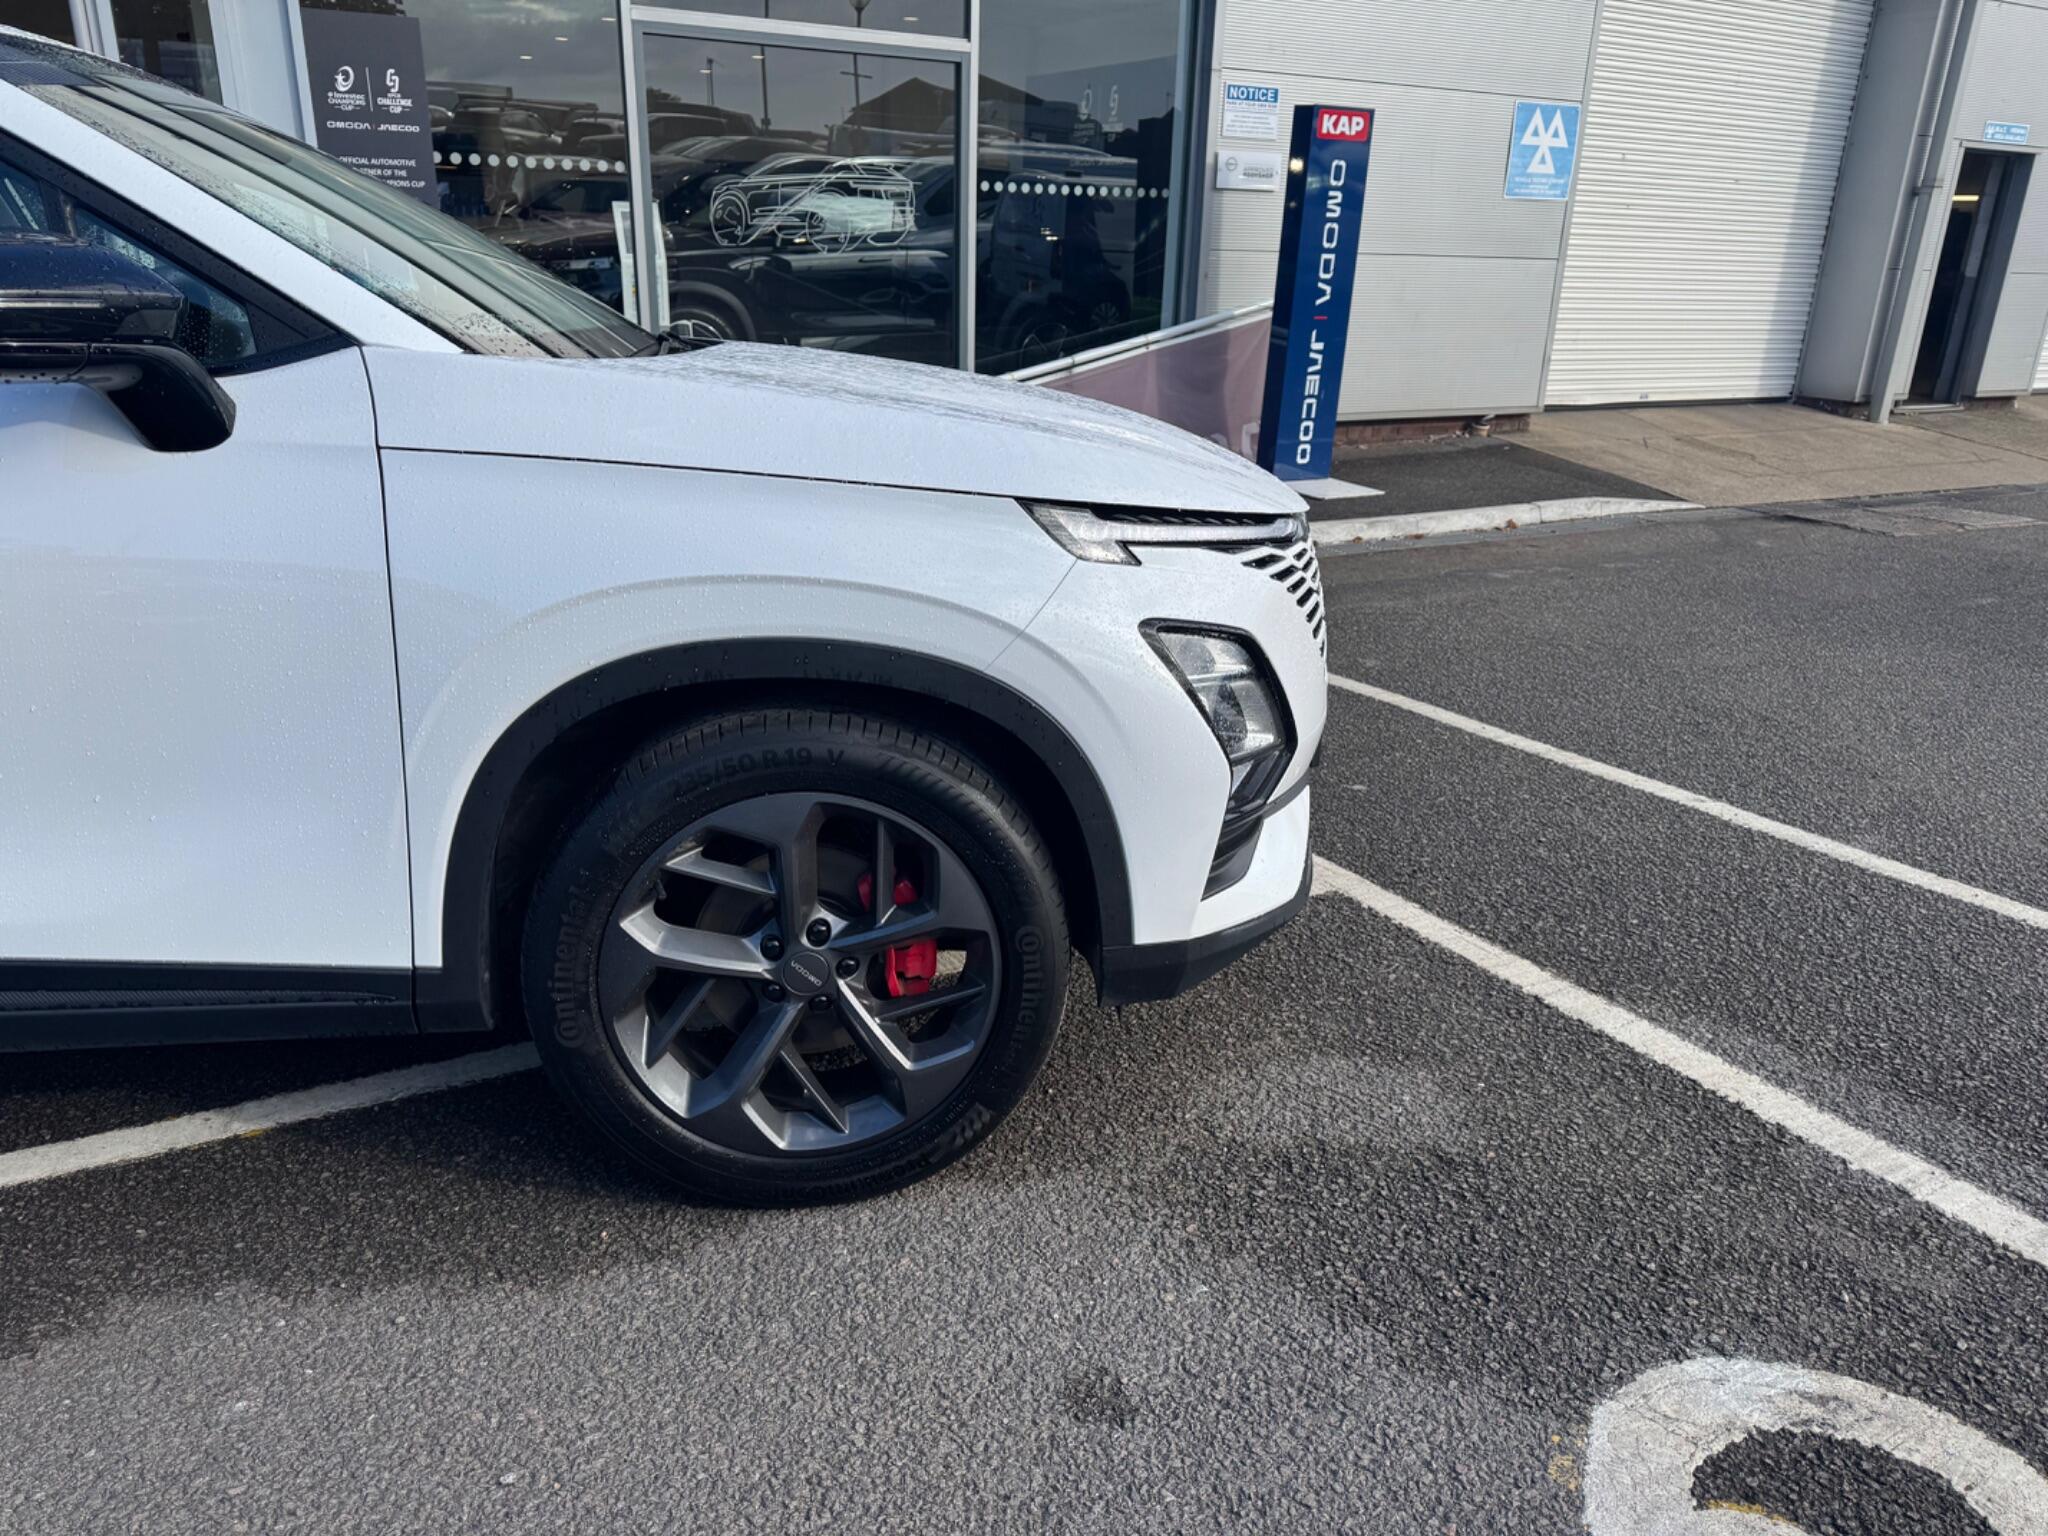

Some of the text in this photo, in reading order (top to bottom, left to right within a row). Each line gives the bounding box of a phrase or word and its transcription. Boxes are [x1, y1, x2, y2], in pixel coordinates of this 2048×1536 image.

[1228, 86, 1276, 102] NOTICE
[377, 97, 413, 107] CHALLENGE
[389, 106, 403, 114] CUP
[327, 120, 371, 130] OMODA
[1321, 113, 1365, 136] KAP
[370, 158, 417, 167] AUTOMOTIVE
[394, 169, 407, 177] THE
[411, 180, 426, 188] CUP
[1295, 159, 1346, 466] OMODA JAECOO
[790, 960, 823, 987] OMODA
